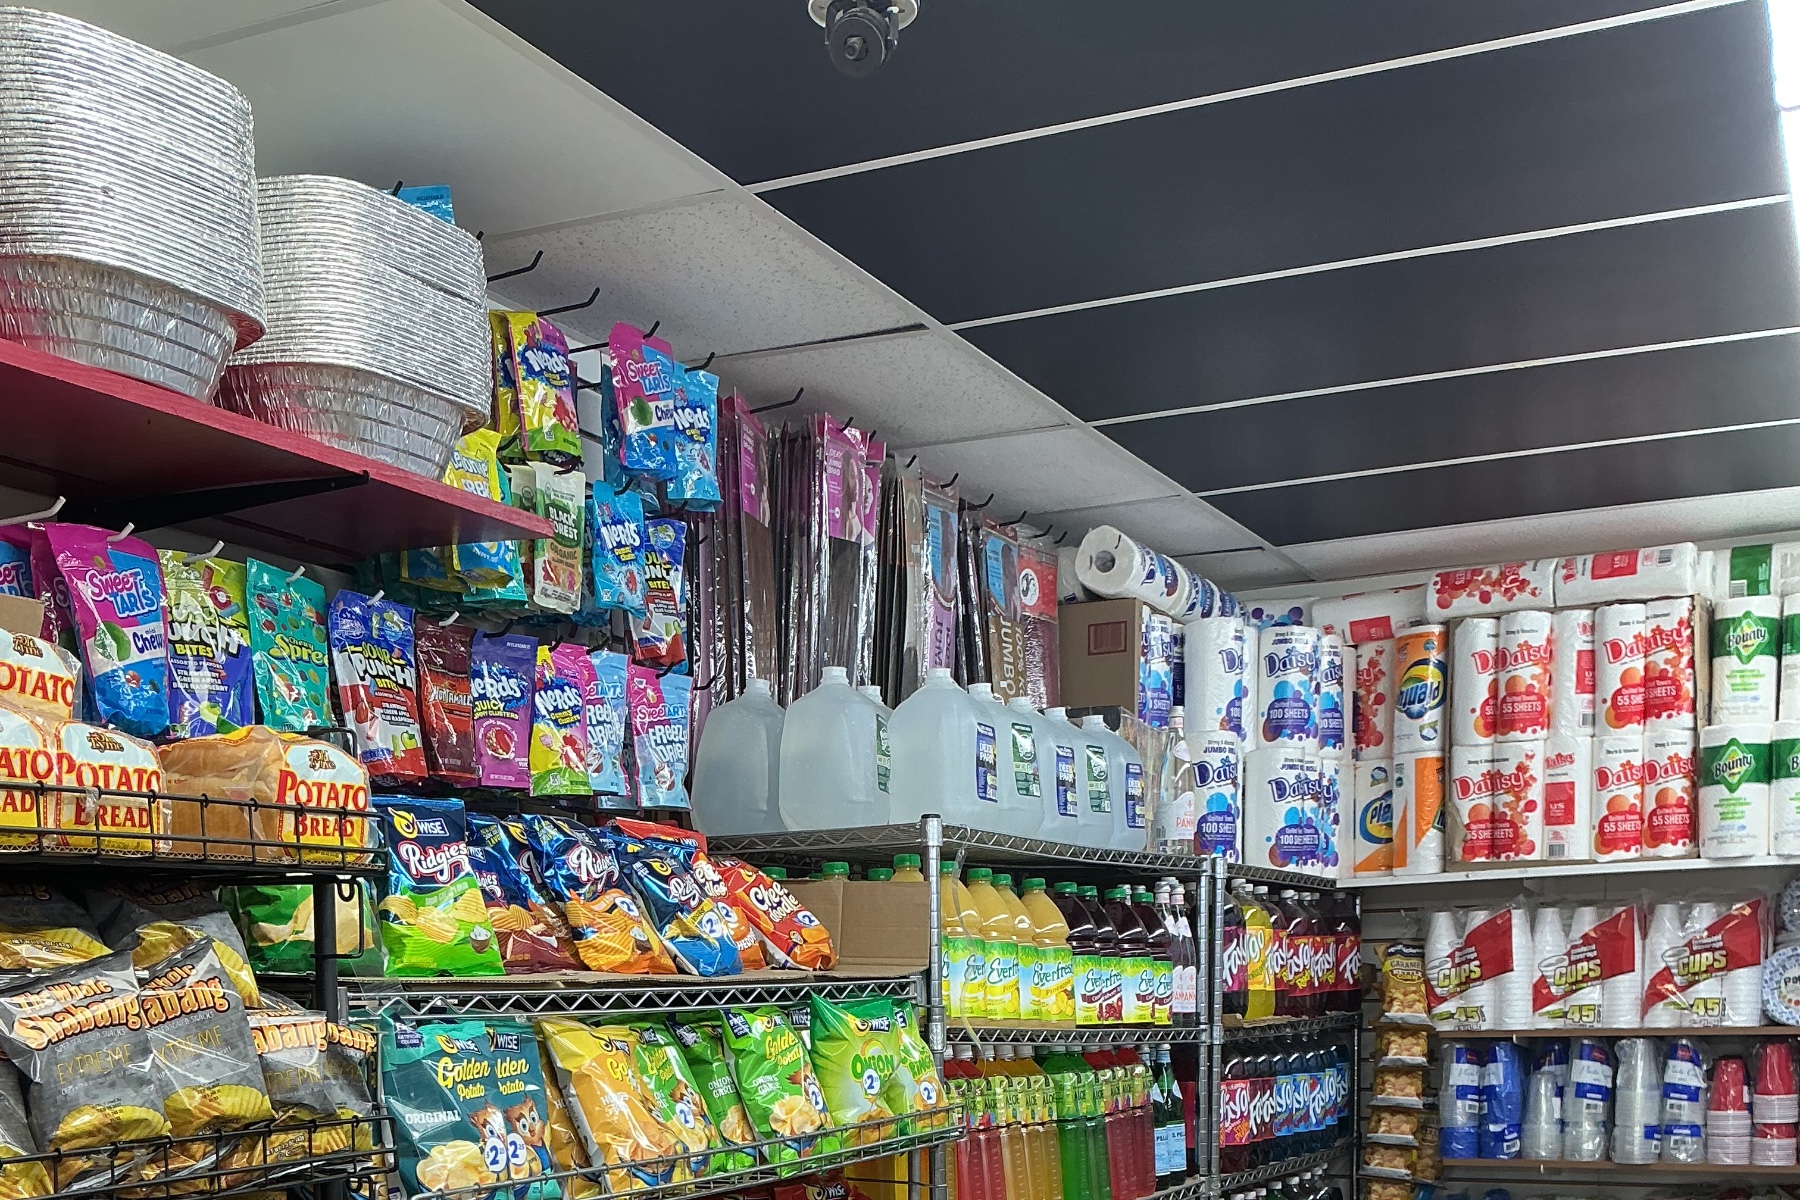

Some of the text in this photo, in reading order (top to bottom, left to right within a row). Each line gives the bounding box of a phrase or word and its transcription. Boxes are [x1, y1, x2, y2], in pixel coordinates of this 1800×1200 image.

[1272, 637, 1293, 646] JUMBO
[1727, 628, 1768, 647] Bounty
[176, 644, 213, 659] BITES
[362, 641, 391, 664] SOUR
[1000, 616, 1016, 695] JUMBO
[1264, 647, 1316, 678] Daisy
[0, 662, 74, 702] OTATO
[1269, 708, 1308, 719] 100 SHEETS
[1513, 701, 1542, 713] SHEETS
[1204, 745, 1226, 754] JUMBO
[57, 751, 162, 791] POTATO
[1714, 754, 1753, 778] Bounty
[276, 768, 367, 812] POTATO
[74, 801, 151, 829] BREAD
[1652, 812, 1690, 825] 55 SHEETS
[295, 815, 355, 838] BREAD
[417, 820, 443, 835] WISE
[1201, 823, 1217, 834] 100
[1603, 821, 1617, 832] 55
[399, 842, 469, 882] Ridgies
[1553, 959, 1602, 986] CUPS
[1677, 950, 1727, 976] CUPS
[1437, 960, 1483, 988] CUPS
[791, 1009, 810, 1024] WISE
[1454, 1006, 1480, 1023] 45
[1567, 1004, 1597, 1023] 45
[1691, 997, 1721, 1017] 45
[871, 1018, 890, 1031] WISE
[455, 1040, 478, 1053] WISE
[497, 1035, 518, 1049] WISE
[57, 1043, 132, 1086] EXTREME
[437, 1056, 491, 1089] Golden
[457, 1083, 485, 1102] Potato
[1006, 1093, 1019, 1106] ALOE
[405, 1110, 462, 1125] ORIGINAL
[827, 1185, 846, 1198] WISE
